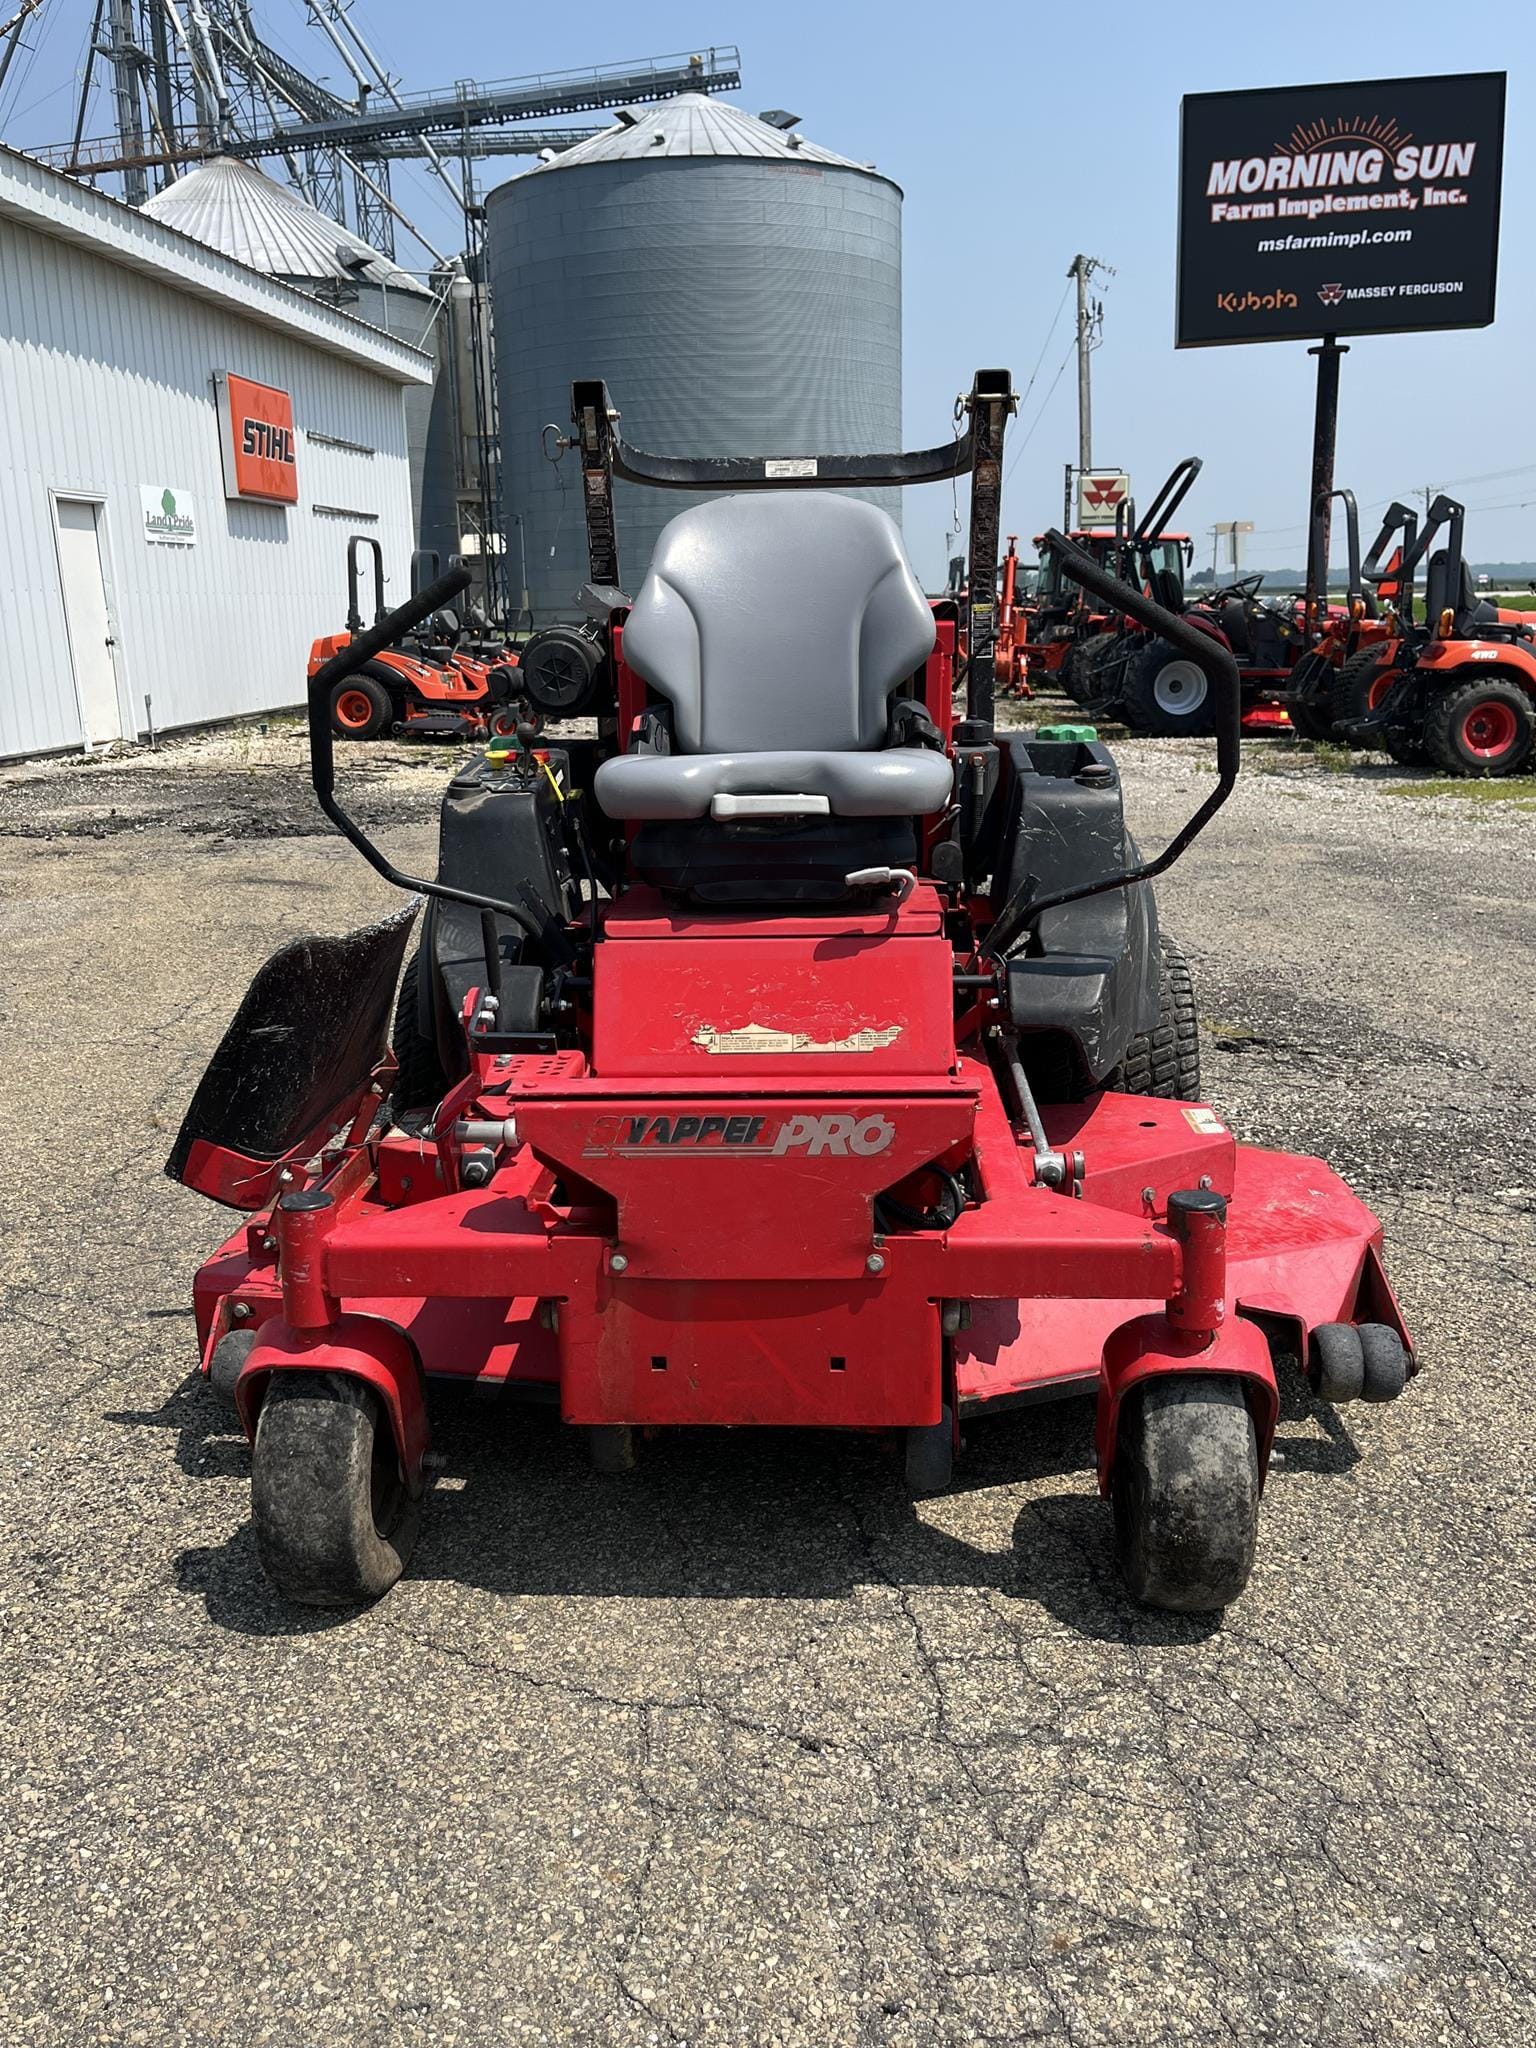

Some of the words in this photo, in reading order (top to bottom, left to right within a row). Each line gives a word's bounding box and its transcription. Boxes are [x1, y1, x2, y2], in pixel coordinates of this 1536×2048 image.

[1206, 148, 1383, 196] MORNING
[1393, 142, 1476, 182] SUN
[1211, 202, 1275, 223] Farm
[1278, 188, 1419, 220] Implement,
[1423, 186, 1468, 206] Inc.
[1257, 229, 1412, 252] msfarmimpl.com
[1217, 289, 1298, 312] Kubota
[1346, 286, 1396, 300] MASSEY
[1399, 281, 1464, 297] FERGUSON
[242, 416, 295, 465] STIHL
[145, 510, 167, 527] Land
[173, 514, 194, 530] Pride
[1471, 650, 1498, 660] 4WD
[772, 1114, 896, 1156] PRO
